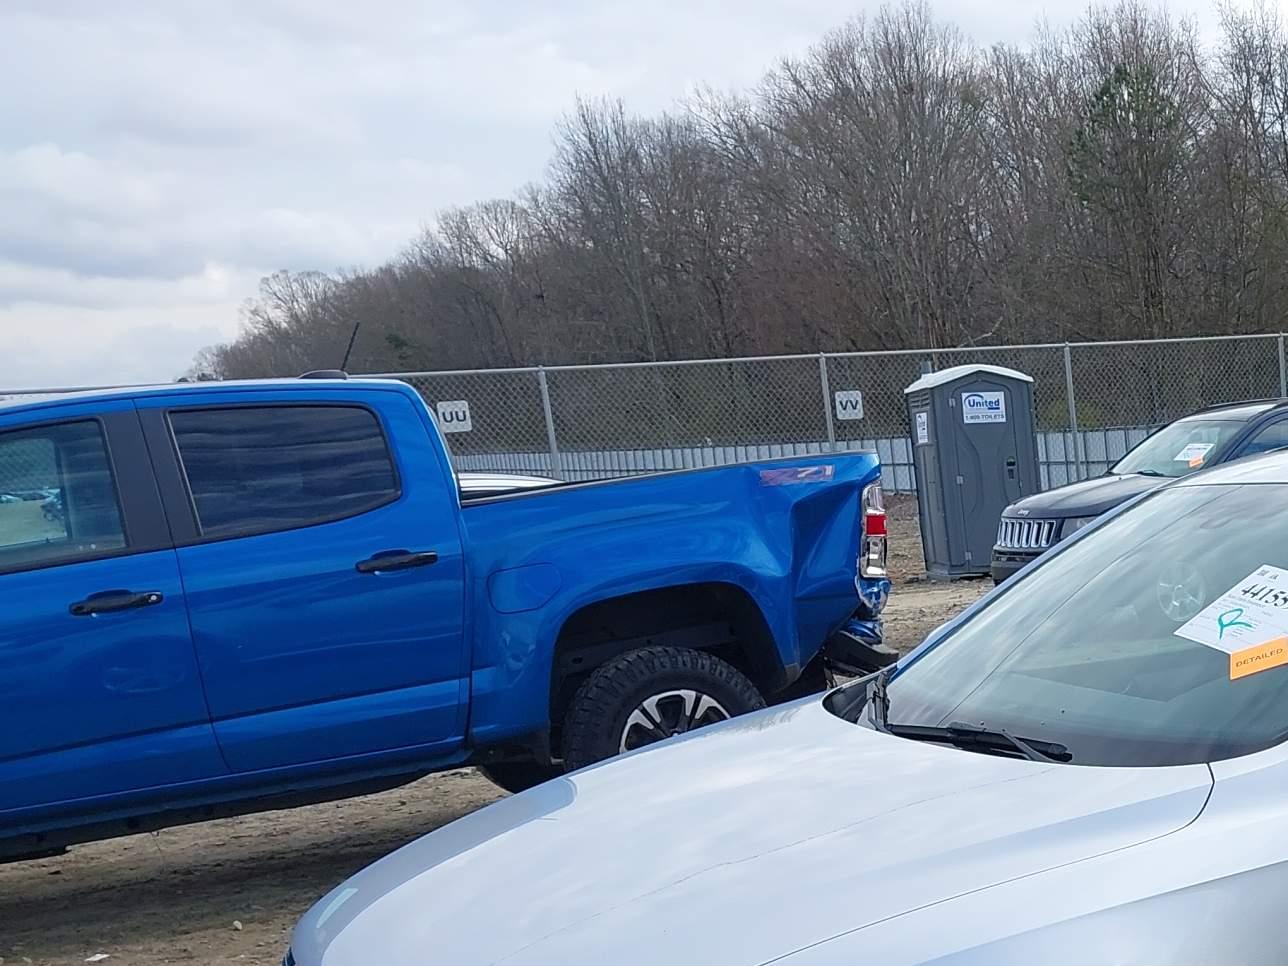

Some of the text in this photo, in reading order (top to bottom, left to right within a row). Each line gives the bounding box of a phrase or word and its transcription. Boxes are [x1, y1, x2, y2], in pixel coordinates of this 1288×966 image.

[839, 400, 859, 410] VV
[967, 398, 1000, 408] United
[442, 410, 467, 423] UU
[1235, 647, 1284, 668] DETAILED
